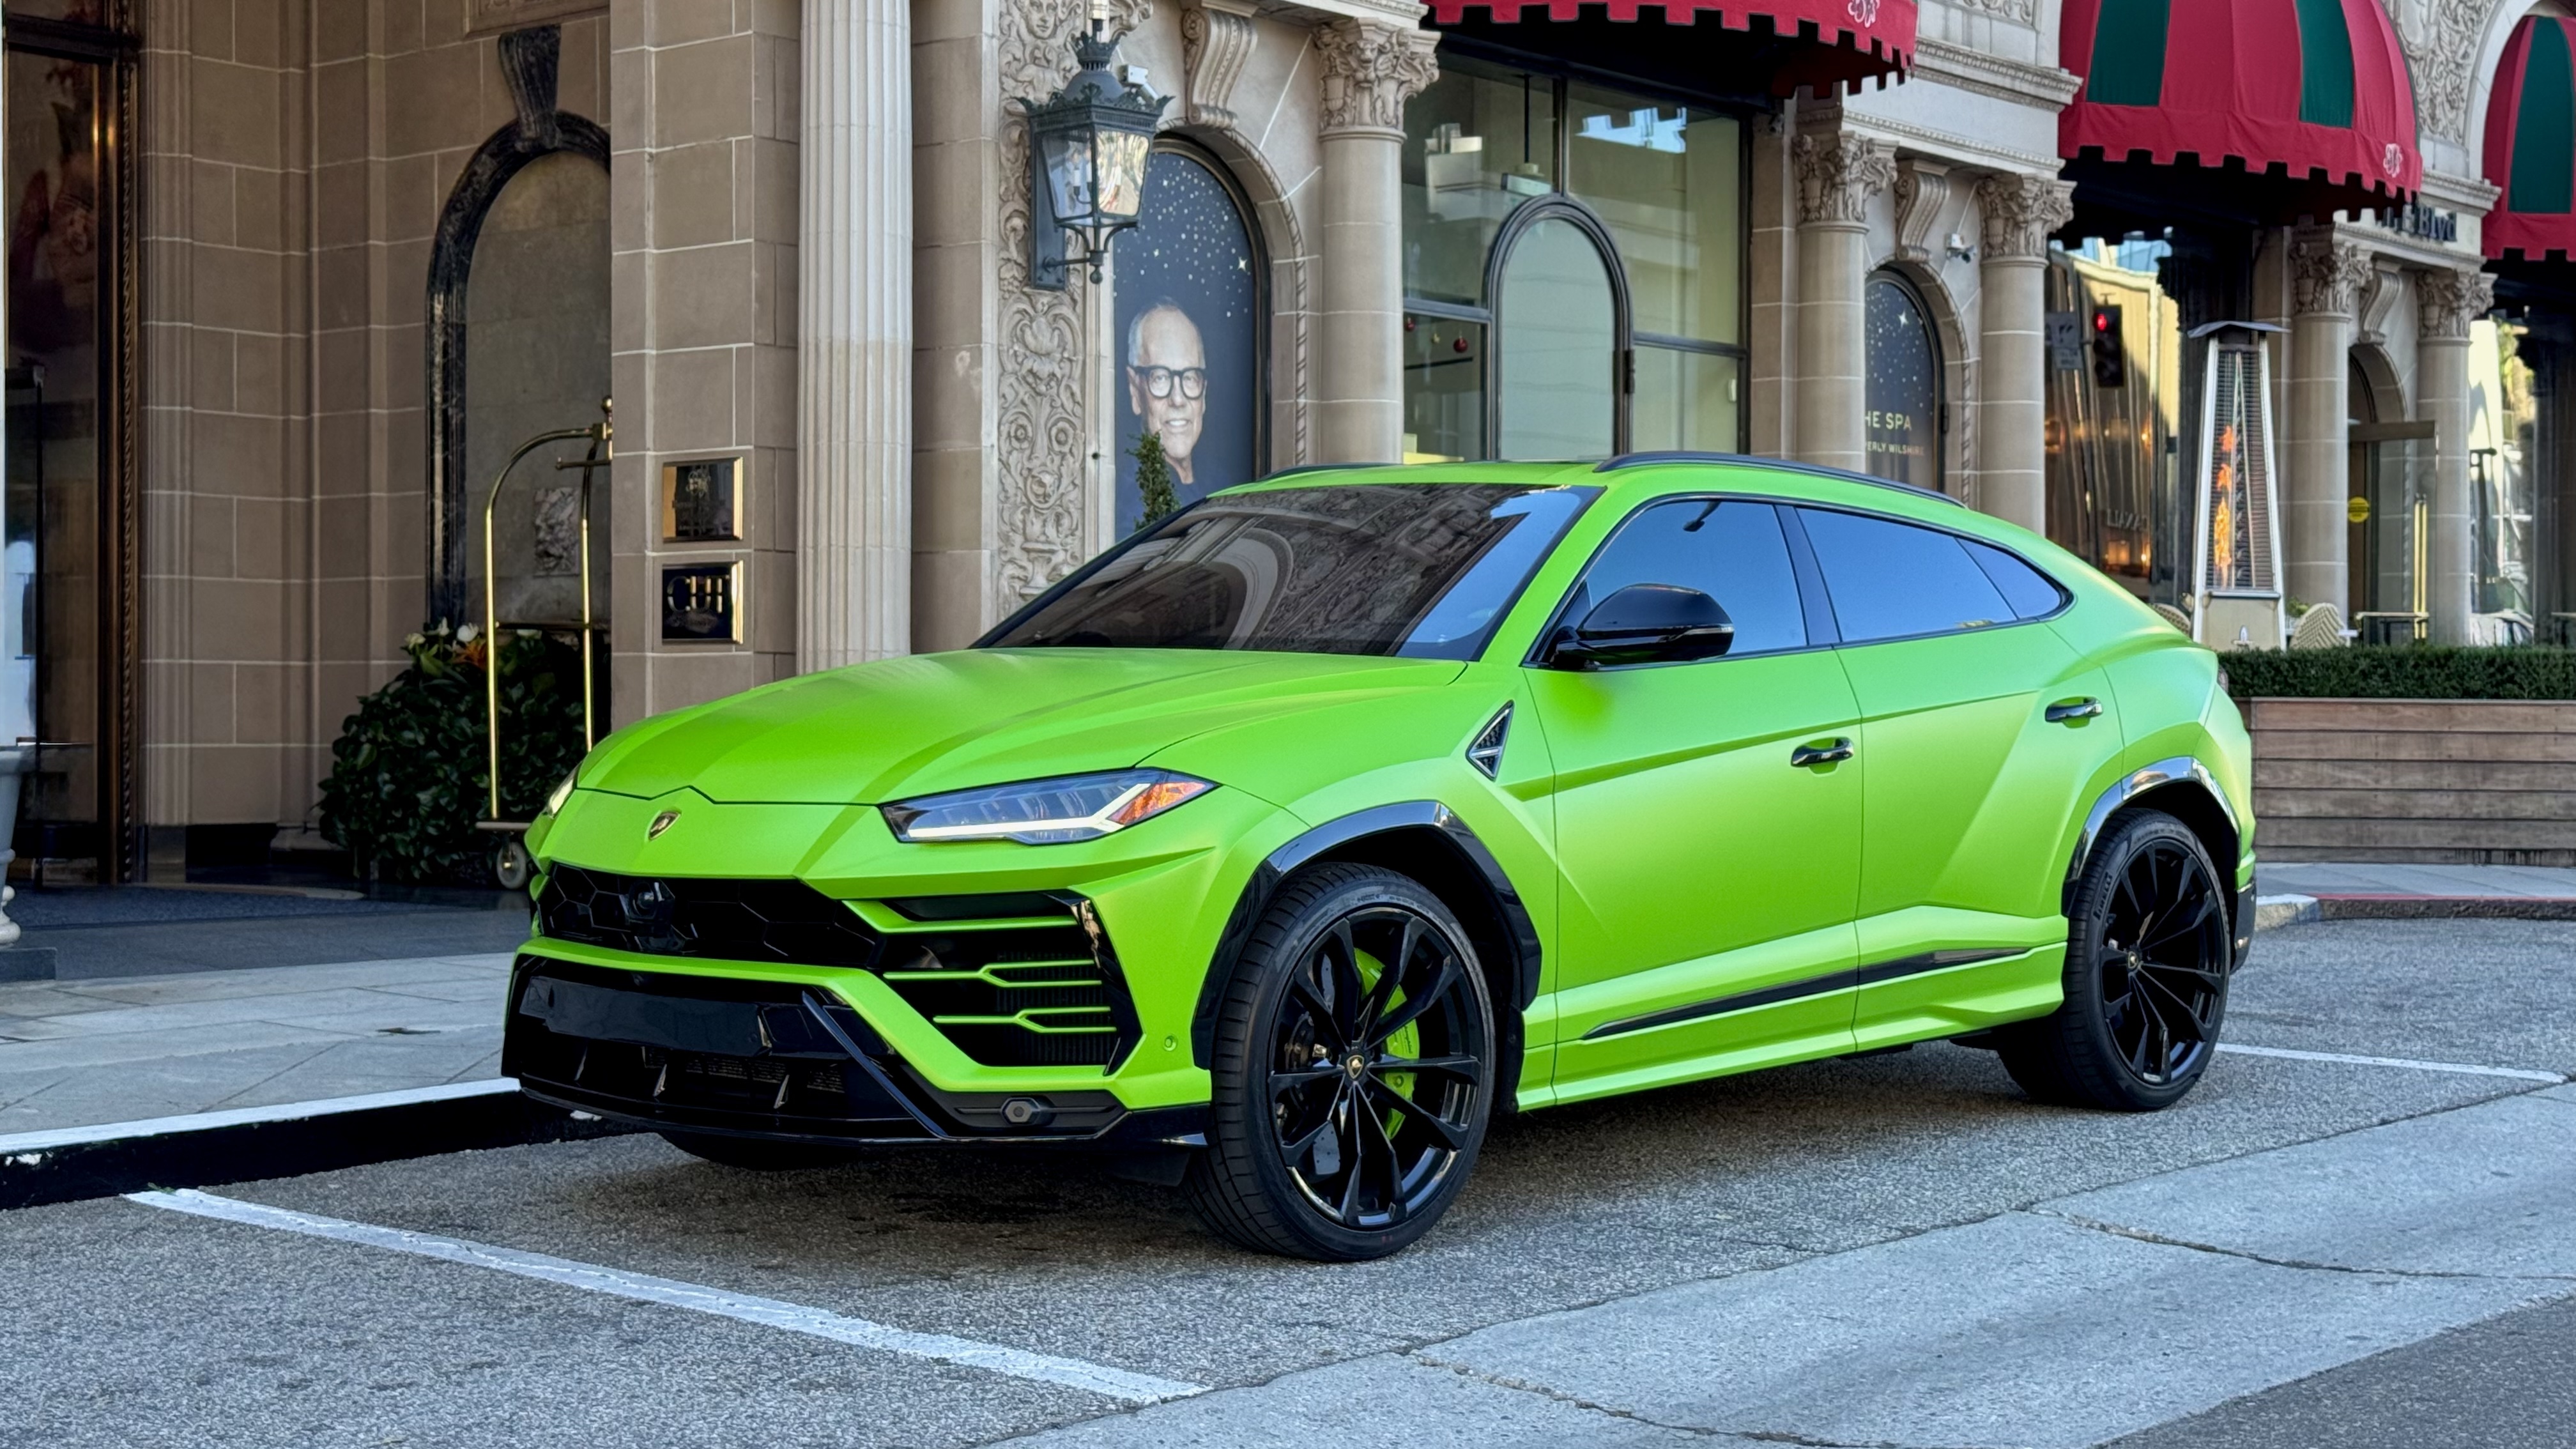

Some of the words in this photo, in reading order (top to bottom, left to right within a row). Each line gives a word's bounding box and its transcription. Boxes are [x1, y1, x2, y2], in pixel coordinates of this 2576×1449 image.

[2418, 206, 2457, 241] Blvd
[1865, 410, 1881, 427] HE
[1885, 412, 1912, 431] SPA
[1866, 440, 1886, 453] ERLY
[1888, 443, 1924, 456] WILSHIRE
[667, 576, 730, 614] CUT
